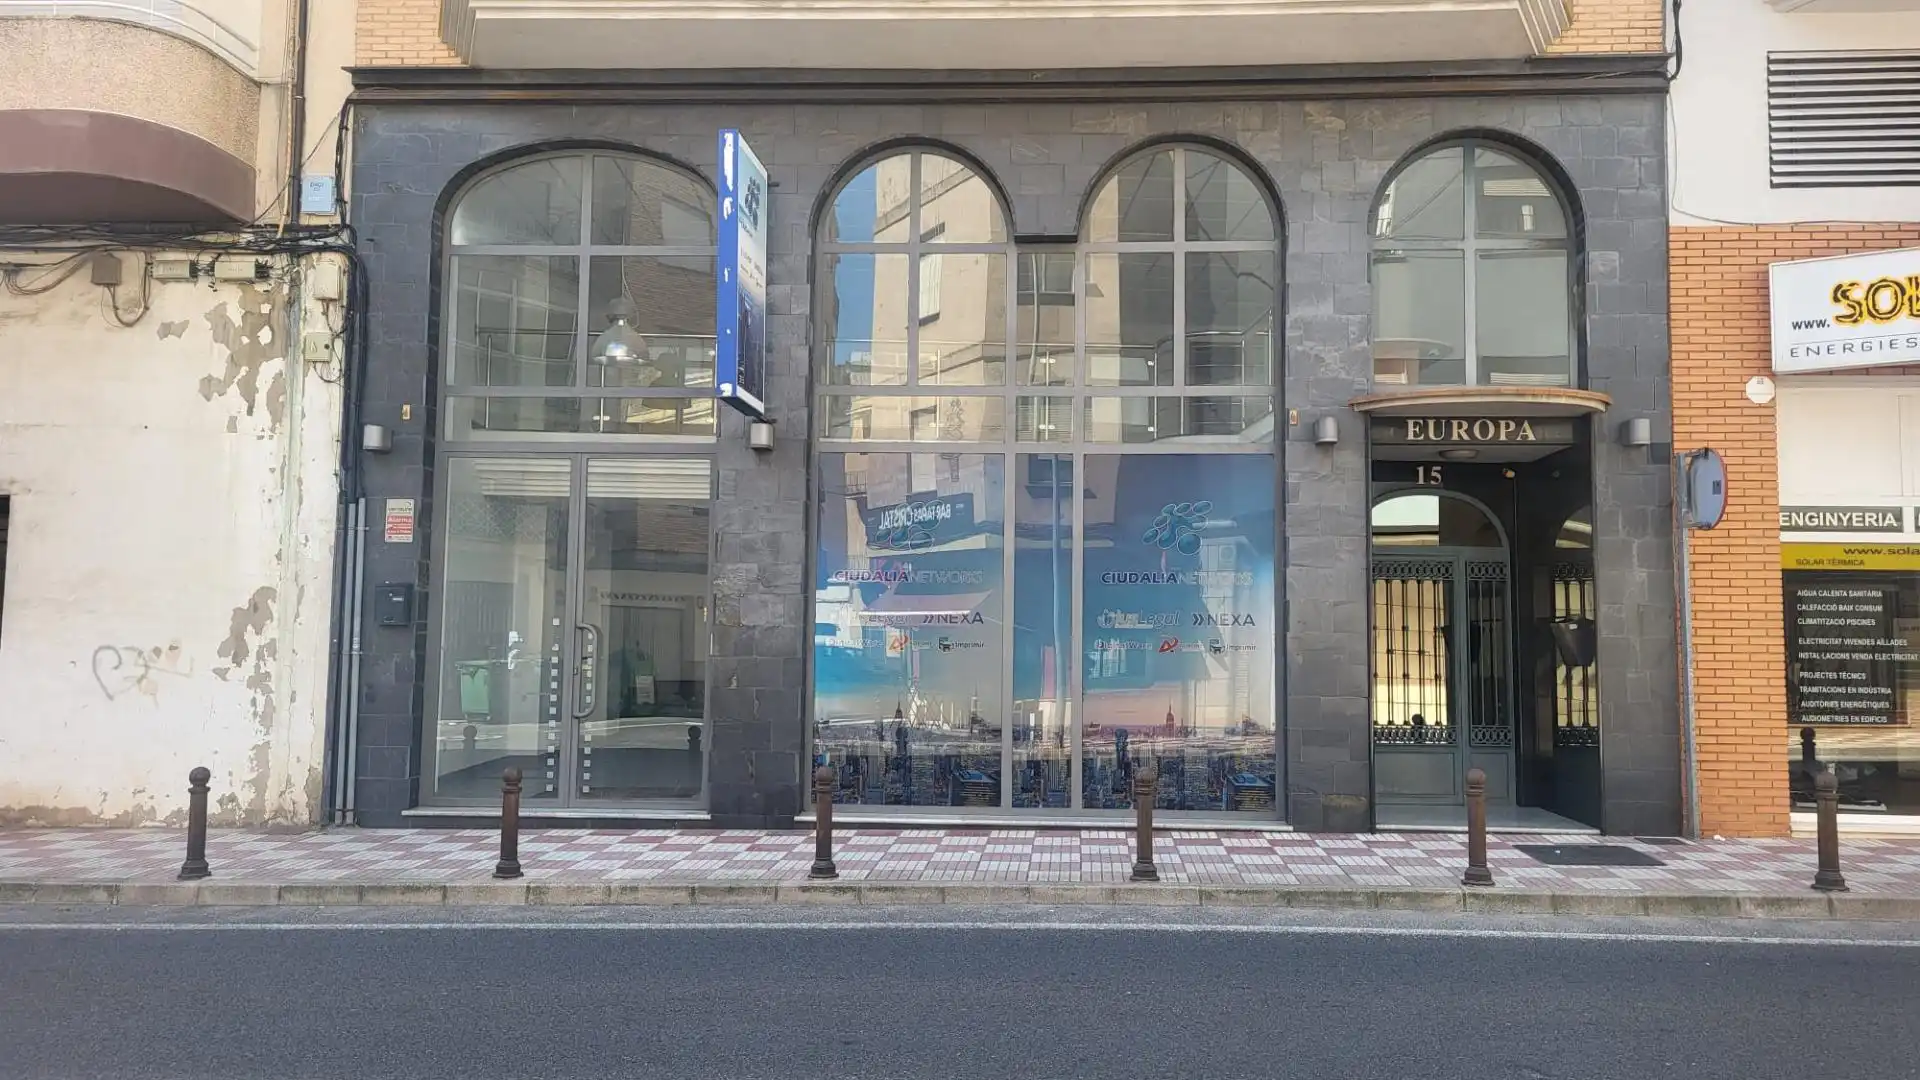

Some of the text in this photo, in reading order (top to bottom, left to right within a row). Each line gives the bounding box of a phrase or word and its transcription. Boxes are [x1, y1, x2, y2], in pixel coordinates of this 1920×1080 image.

[1790, 337, 1918, 358] ENERGIES
[1406, 418, 1537, 441] EUROPA
[1415, 465, 1442, 485] 15
[1780, 512, 1898, 527] ENGINYERIA
[1795, 558, 1825, 566] SOLAR
[1797, 589, 1818, 597] AIGUA
[1818, 589, 1848, 597] CALENTA
[937, 612, 985, 625] NEXA
[1207, 613, 1256, 627] NEXA
[1846, 618, 1876, 626] PISCINES
[1798, 637, 1843, 645] ELECTRICITAT
[1843, 638, 1875, 646] VIVENDES
[1851, 652, 1873, 660] VENDA
[1874, 653, 1918, 661] ELECTRICITAT
[1799, 671, 1838, 679] PROJECTES
[1799, 686, 1846, 694] TRAMITACIONS
